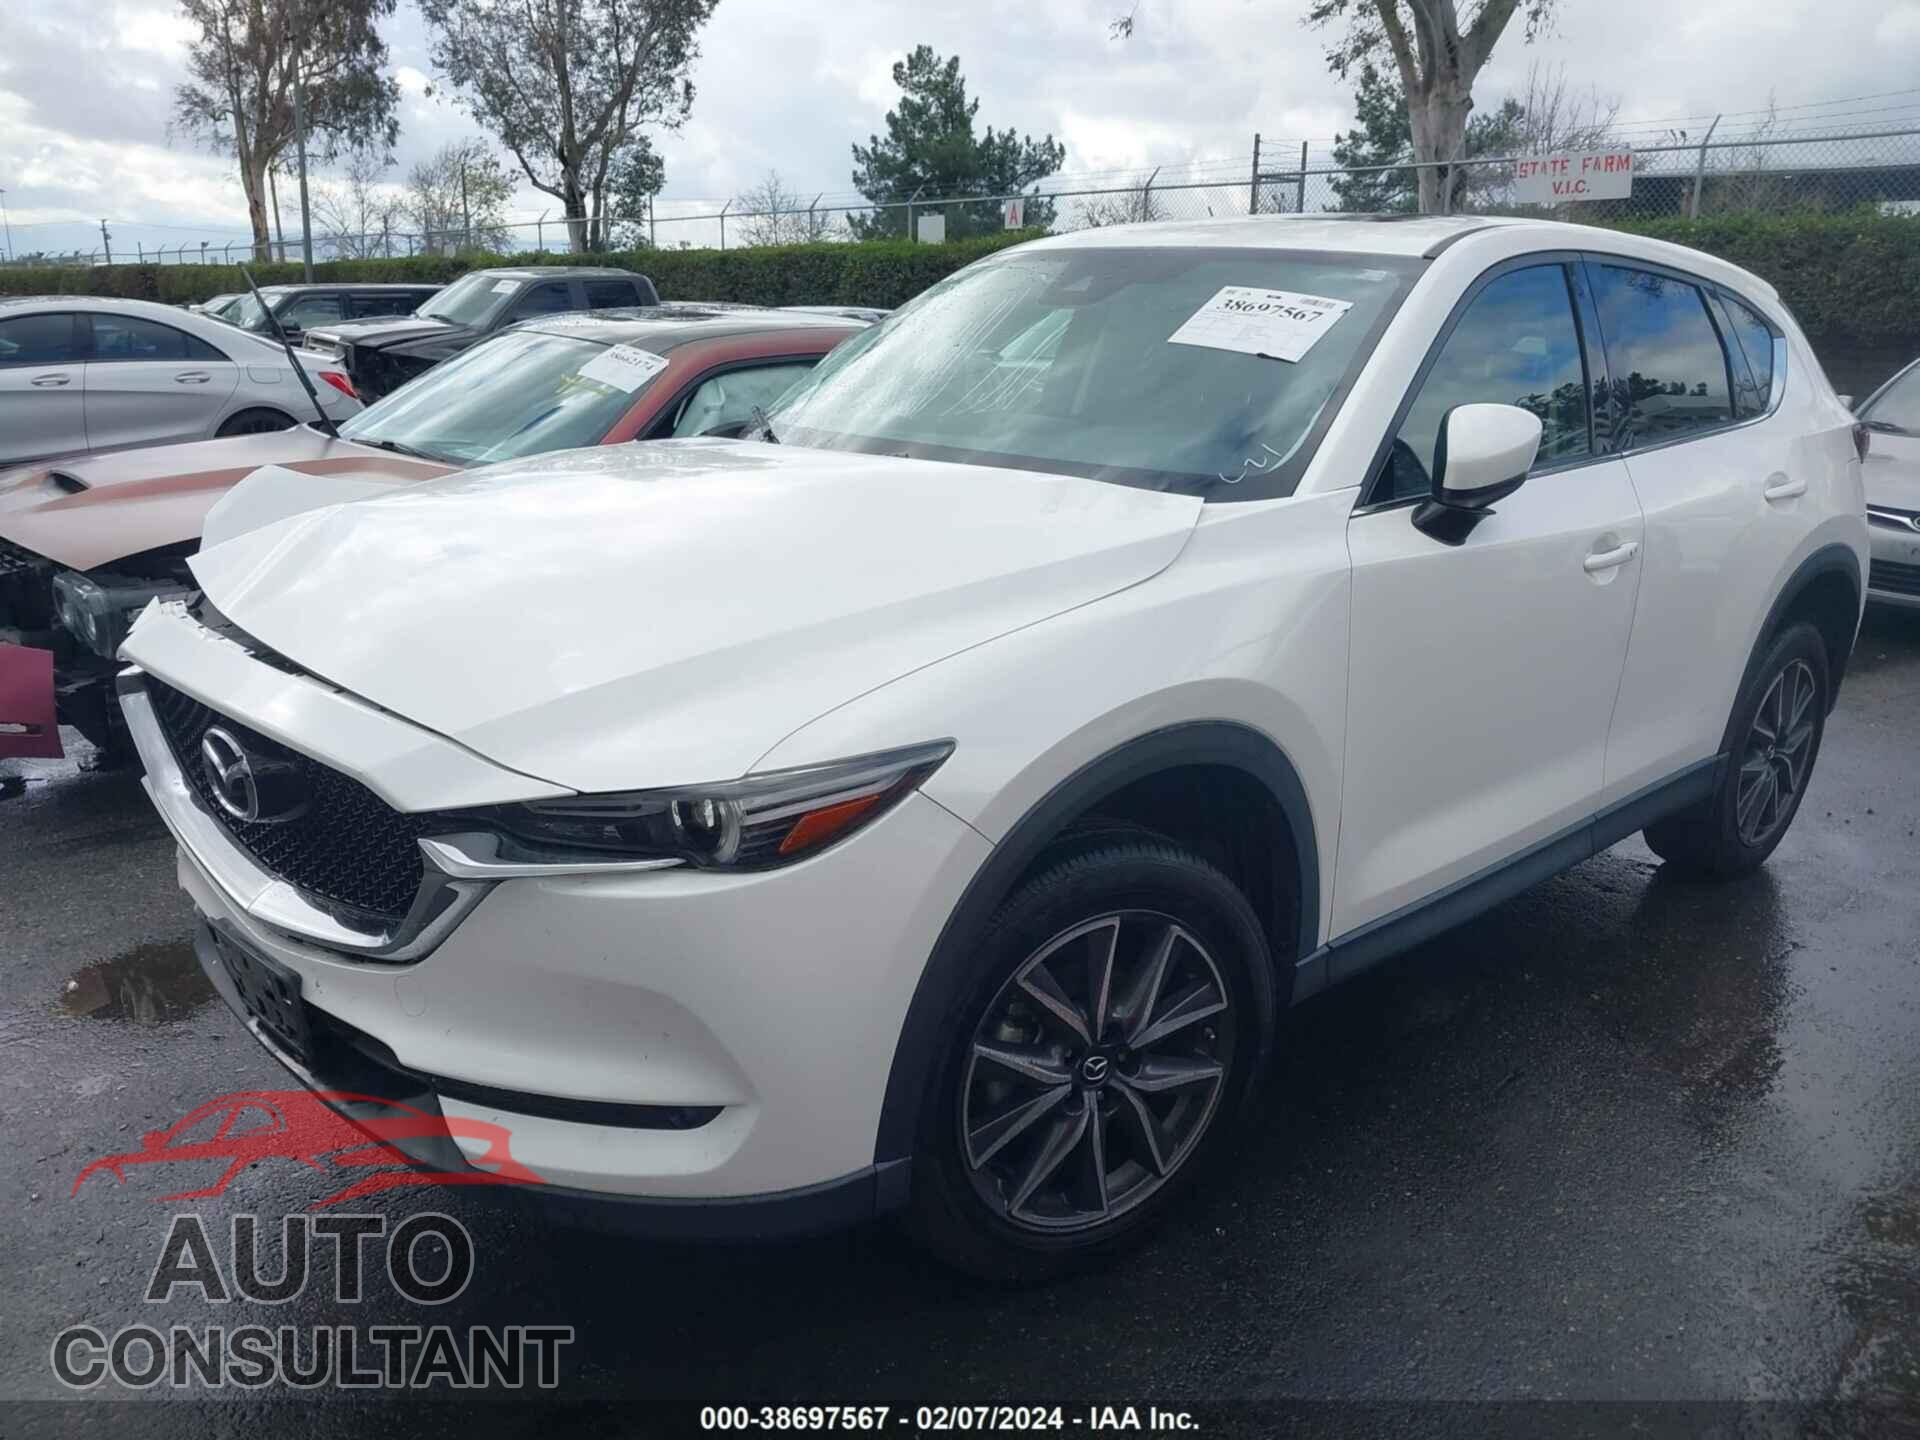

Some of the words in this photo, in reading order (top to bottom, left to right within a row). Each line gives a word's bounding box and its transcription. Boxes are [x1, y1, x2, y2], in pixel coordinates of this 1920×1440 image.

[1518, 158, 1570, 178] STATE
[1581, 154, 1632, 174] FARM
[1552, 180, 1590, 195] V.I.C.
[1008, 202, 1018, 225] A
[1216, 299, 1323, 322] 38697567
